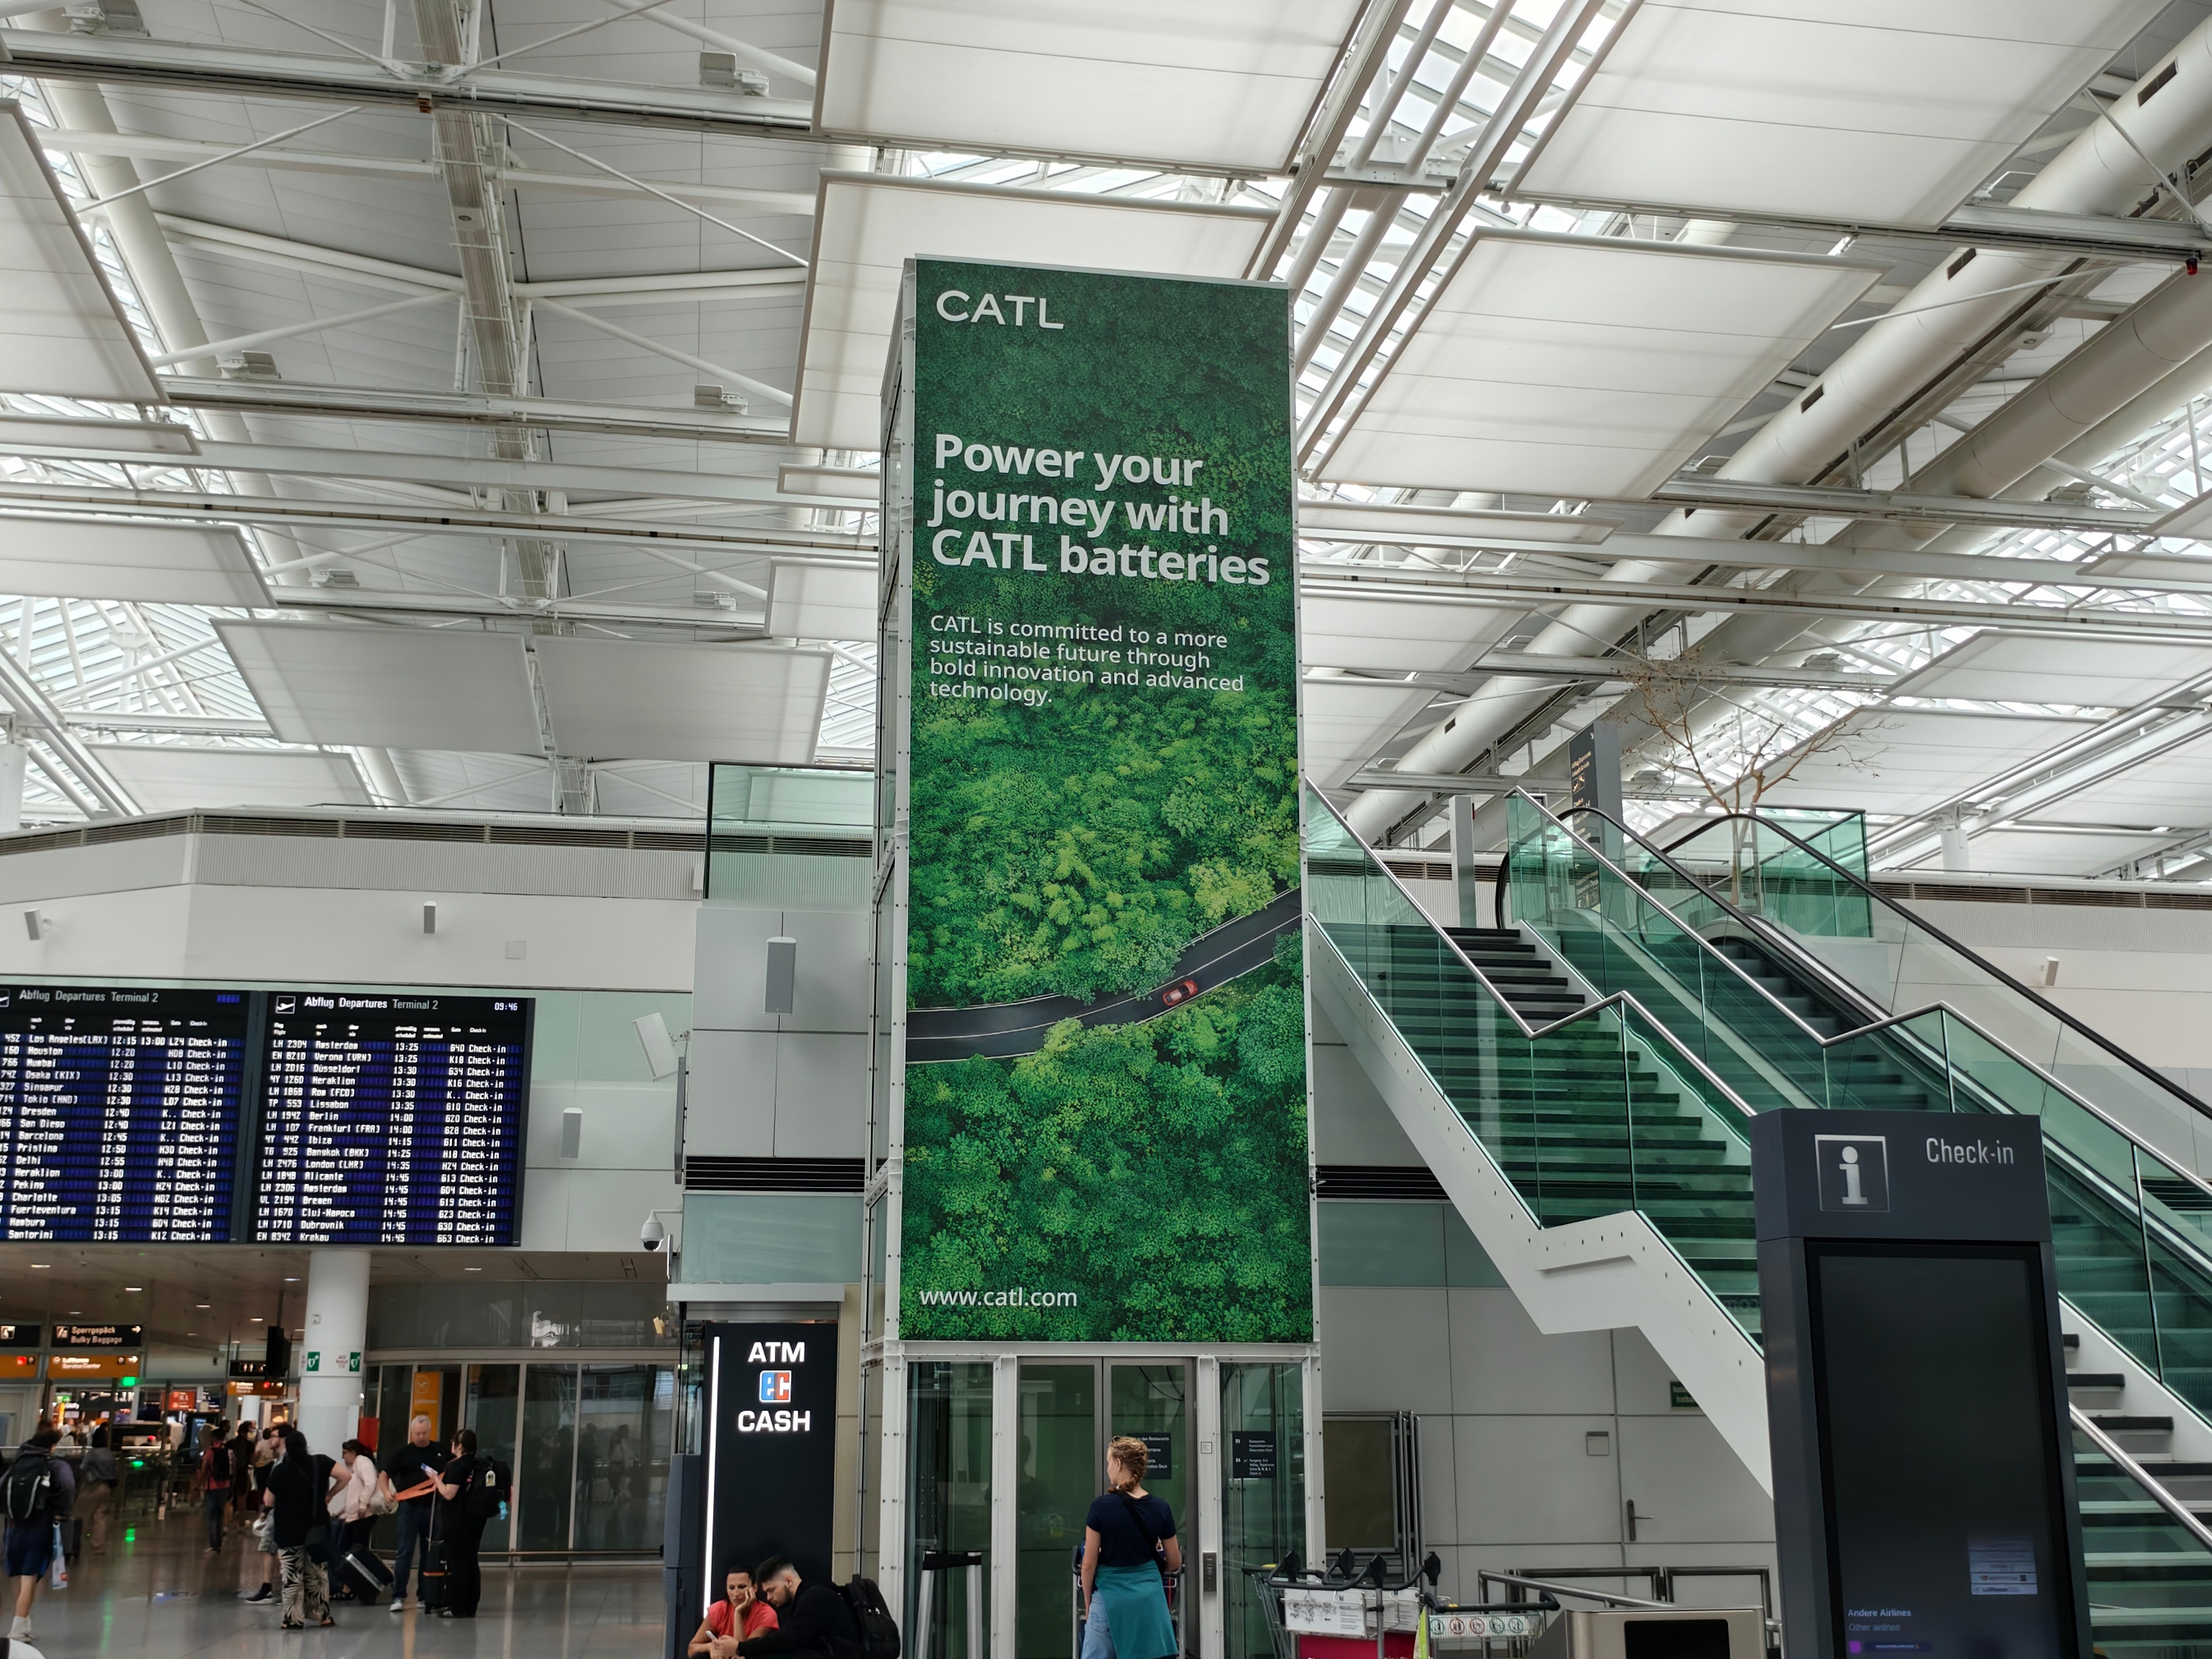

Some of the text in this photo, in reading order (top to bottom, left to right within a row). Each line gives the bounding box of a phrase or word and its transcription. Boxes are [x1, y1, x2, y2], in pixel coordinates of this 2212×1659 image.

[936, 290, 1064, 329] CATL
[935, 434, 1203, 491] Power your
[927, 480, 1228, 537] journey with
[932, 529, 1270, 585] CATL batteries
[930, 615, 1228, 648] CATL is committed to a more
[930, 639, 1210, 671] sustainable future through
[931, 657, 1243, 691] bold innovation and advanced
[929, 681, 1052, 708] technology.
[19, 989, 158, 1003] Abflug Departures Terminal 2
[304, 996, 439, 1010] Abflug Departures Terminal 2
[494, 1002, 518, 1011] 09:46
[112, 1036, 137, 1046] 12:15
[141, 1036, 166, 1046] 13:00
[187, 1037, 227, 1047] Check-in
[395, 1042, 419, 1051] 13:25
[468, 1044, 506, 1053] Check-in
[111, 1048, 136, 1057] 12:20
[187, 1049, 226, 1059] Check-in
[394, 1054, 418, 1063] 13:25
[468, 1056, 505, 1065] Check-in
[110, 1060, 134, 1069] 12:20
[186, 1061, 225, 1071] Check-in
[394, 1065, 417, 1075] 13:30
[467, 1067, 505, 1077] Check-in
[109, 1072, 133, 1081] 12:30
[185, 1073, 224, 1083] Check-in
[393, 1077, 416, 1087] 13:30
[466, 1079, 504, 1088] Check-in
[107, 1084, 132, 1093] 12:30
[183, 1085, 224, 1095] Check-in
[392, 1089, 415, 1098] 13:30
[465, 1091, 503, 1100] Check-in
[106, 1096, 131, 1105] 12:30
[182, 1097, 222, 1107] Check-in
[391, 1101, 415, 1110] 13:35
[464, 1103, 503, 1112] Check-in
[105, 1108, 130, 1117] 12:40
[181, 1109, 221, 1118] Check-in
[390, 1113, 414, 1122] 14:00
[463, 1114, 502, 1124] Check-in
[104, 1120, 129, 1130] 12:40
[180, 1121, 220, 1131] Check-in
[389, 1125, 413, 1134] 14:00
[463, 1126, 501, 1135] Check-in
[103, 1132, 127, 1142] 12:45
[179, 1133, 219, 1143] Check-in
[388, 1137, 412, 1146] 14:15
[462, 1138, 500, 1148] Check-in
[102, 1144, 126, 1154] 12:50
[178, 1145, 218, 1155] Check-in
[387, 1149, 411, 1158] 14:25
[461, 1150, 500, 1159] Check-in
[1926, 1137, 2014, 1164] Check-in
[100, 1156, 125, 1166] 12:55
[177, 1157, 217, 1167] Check-in
[387, 1161, 410, 1170] 14:35
[460, 1162, 498, 1171] Check-in
[99, 1169, 124, 1178] 13:00
[176, 1170, 216, 1179] Check-in
[386, 1173, 409, 1182] 14:45
[460, 1174, 498, 1183] Check-in
[98, 1181, 123, 1191] 13:00
[174, 1182, 215, 1191] Check-in
[385, 1185, 409, 1194] 14:45
[458, 1186, 497, 1195] Check-in
[97, 1193, 122, 1203] 13:05
[173, 1194, 214, 1204] Check-in
[384, 1197, 408, 1206] 14:45
[458, 1198, 496, 1207] Check-in
[96, 1205, 120, 1215] 13:15
[172, 1206, 213, 1216] Check-in
[383, 1209, 496, 1219] 14:45 Check-in
[95, 1218, 119, 1228] 13:15
[171, 1218, 212, 1228] Check-in
[382, 1221, 406, 1231] 14:45
[456, 1222, 495, 1231] Check-in
[93, 1230, 118, 1240] 13:15
[170, 1231, 211, 1241] Check-in
[381, 1233, 405, 1243] 14:45
[455, 1234, 494, 1243] Check-in
[920, 1287, 1077, 1306] www.catl.com
[71, 1336, 123, 1344] Bulky Baggage
[748, 1341, 805, 1363] ATM
[738, 1410, 811, 1432] CASH
[1847, 1609, 1912, 1617] Andere Airlines
